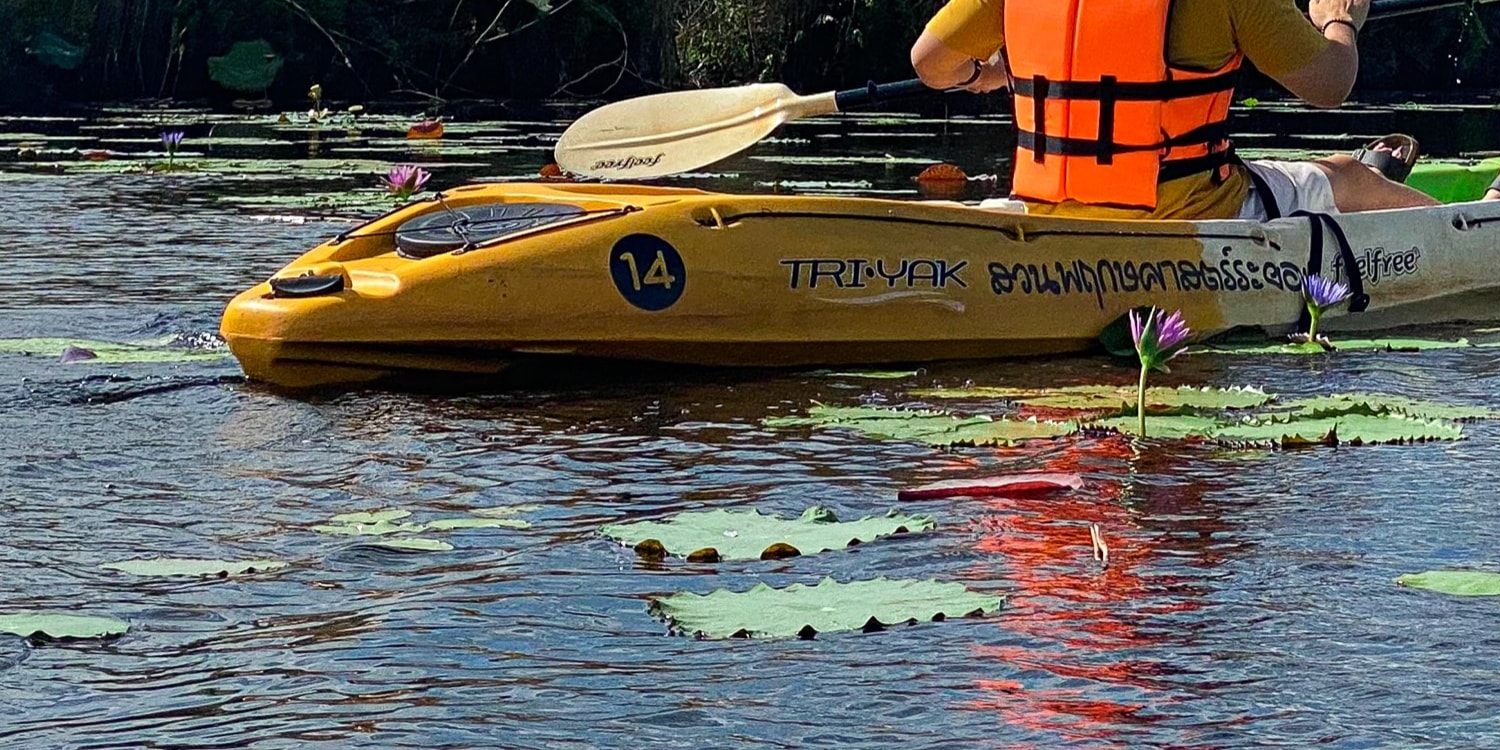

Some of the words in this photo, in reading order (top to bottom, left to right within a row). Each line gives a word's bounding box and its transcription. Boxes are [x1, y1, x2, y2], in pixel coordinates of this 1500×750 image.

[590, 152, 666, 171] feelfree
[619, 250, 675, 290] 14
[988, 246, 1308, 310] สวนพฤกษศาสตร์ระยอ
[1331, 246, 1420, 286] felfree
